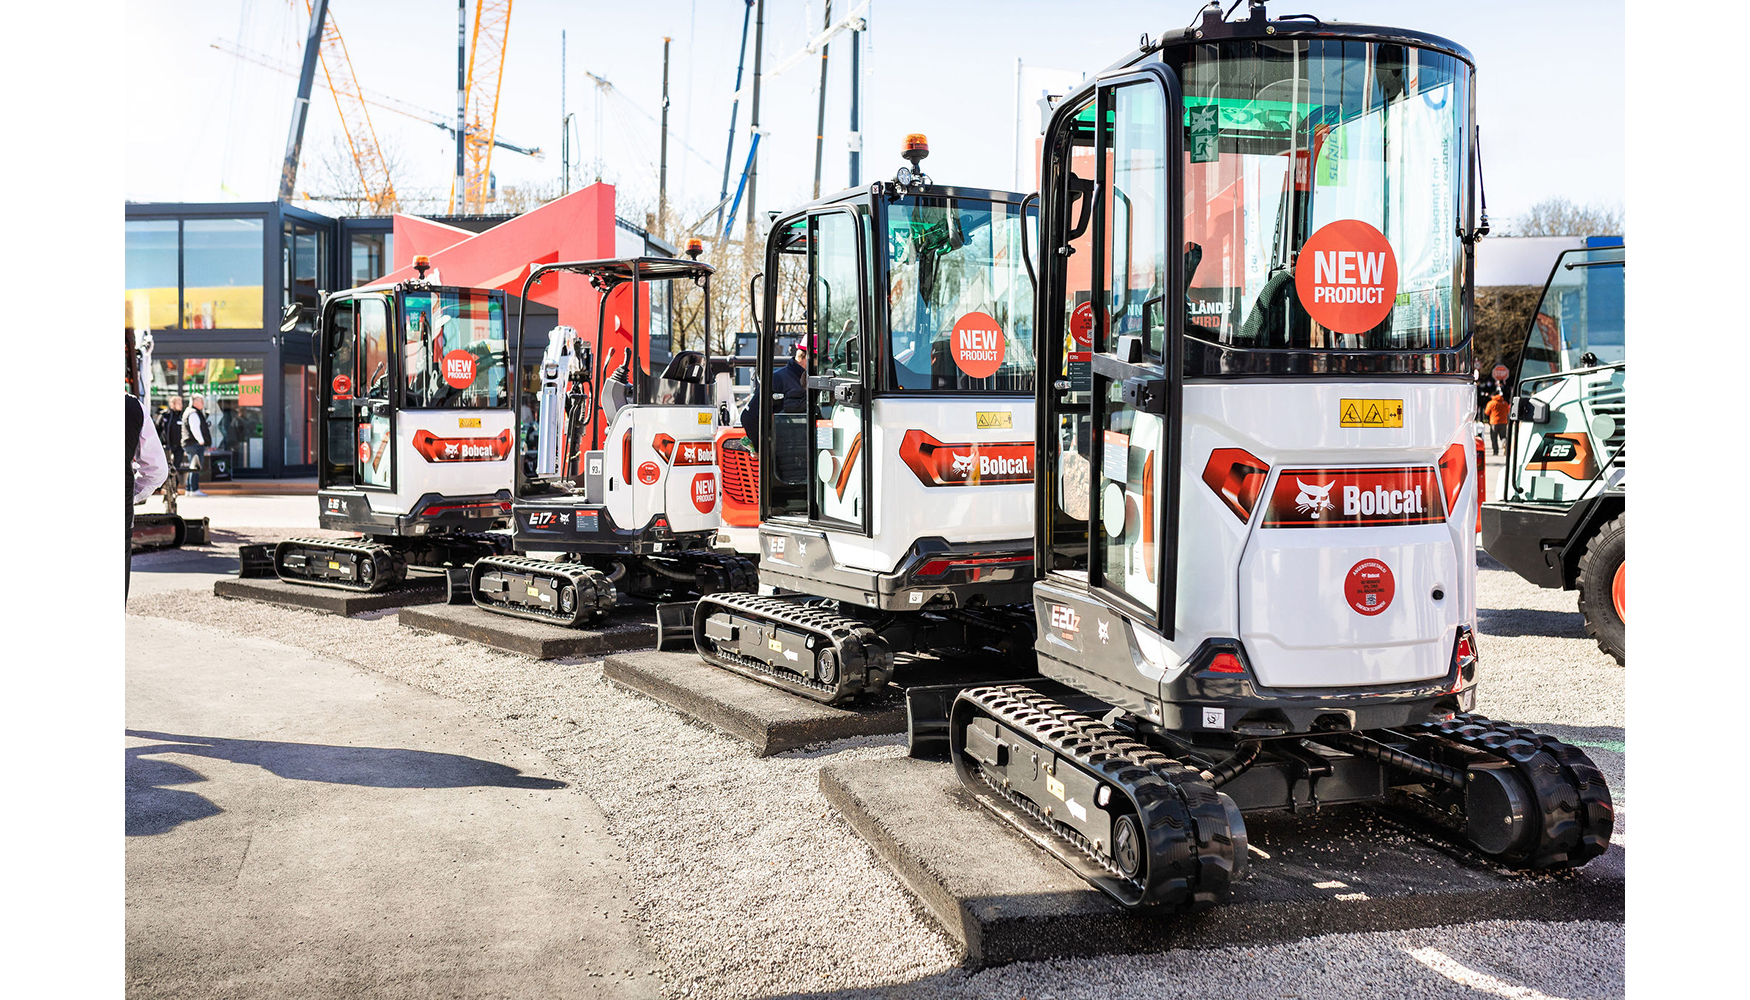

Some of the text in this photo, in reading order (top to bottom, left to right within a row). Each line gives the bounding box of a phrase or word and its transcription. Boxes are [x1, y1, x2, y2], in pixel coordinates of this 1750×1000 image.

[1431, 157, 1440, 180] mit
[1431, 181, 1441, 233] beginnt
[1314, 250, 1386, 285] NEW
[1314, 286, 1385, 304] PRODUCT
[959, 329, 998, 350] NEW
[960, 350, 998, 361] PRODUCT
[447, 359, 472, 373] NEW
[447, 371, 472, 380] PRODUCT
[461, 444, 493, 457] Bobcat
[591, 465, 599, 474] 93
[980, 455, 1029, 475] Bobcat
[695, 479, 715, 495] NEW
[696, 494, 715, 503] PRODUCT
[1343, 484, 1423, 516] Bobcat
